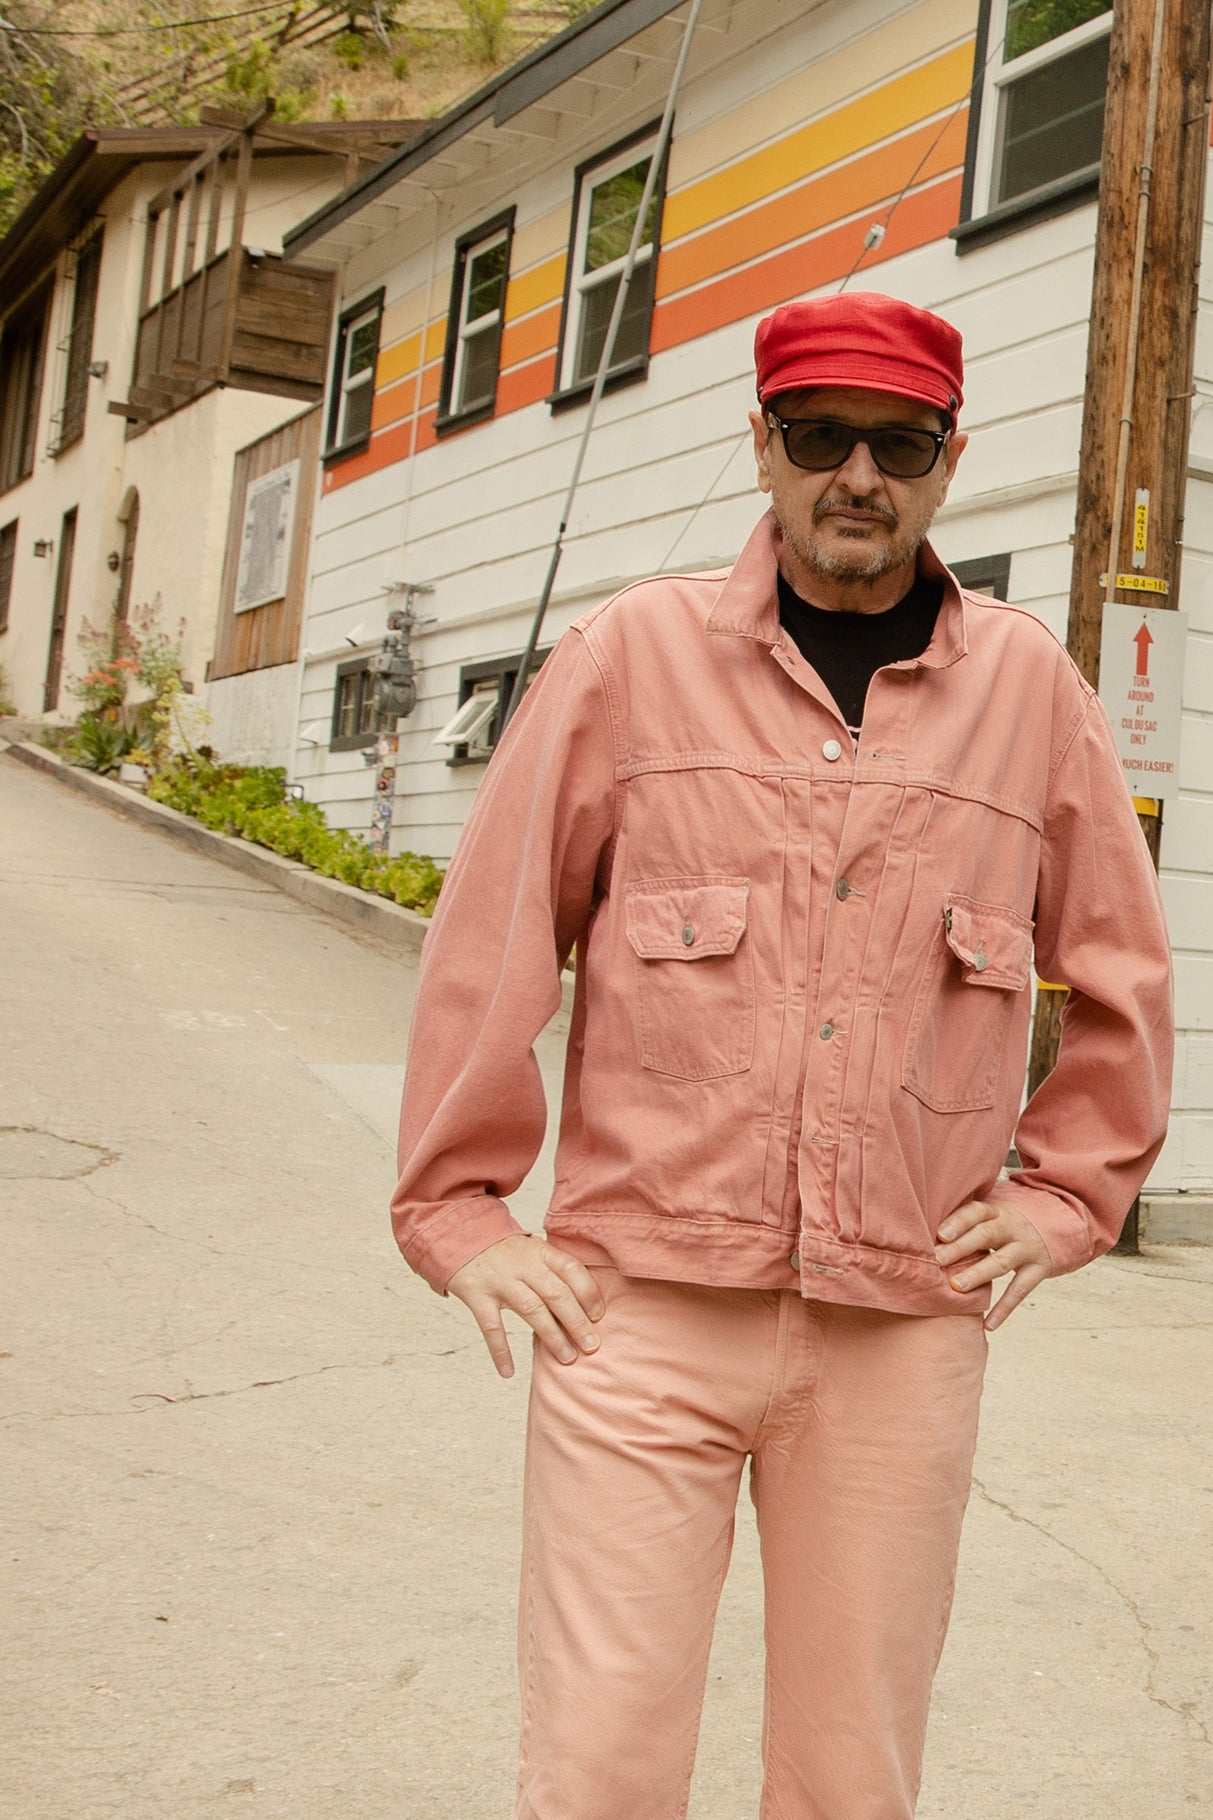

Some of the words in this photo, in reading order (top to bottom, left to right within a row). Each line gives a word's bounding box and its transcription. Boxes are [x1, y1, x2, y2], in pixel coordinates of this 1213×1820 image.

[1133, 676, 1150, 687] TURN
[1128, 690, 1153, 702] AROUND
[1136, 705, 1144, 715] AT
[1122, 718, 1134, 729] CUL
[1144, 720, 1157, 732] SAC
[1130, 734, 1146, 744] ONLY
[1144, 760, 1174, 773] EASIER!
